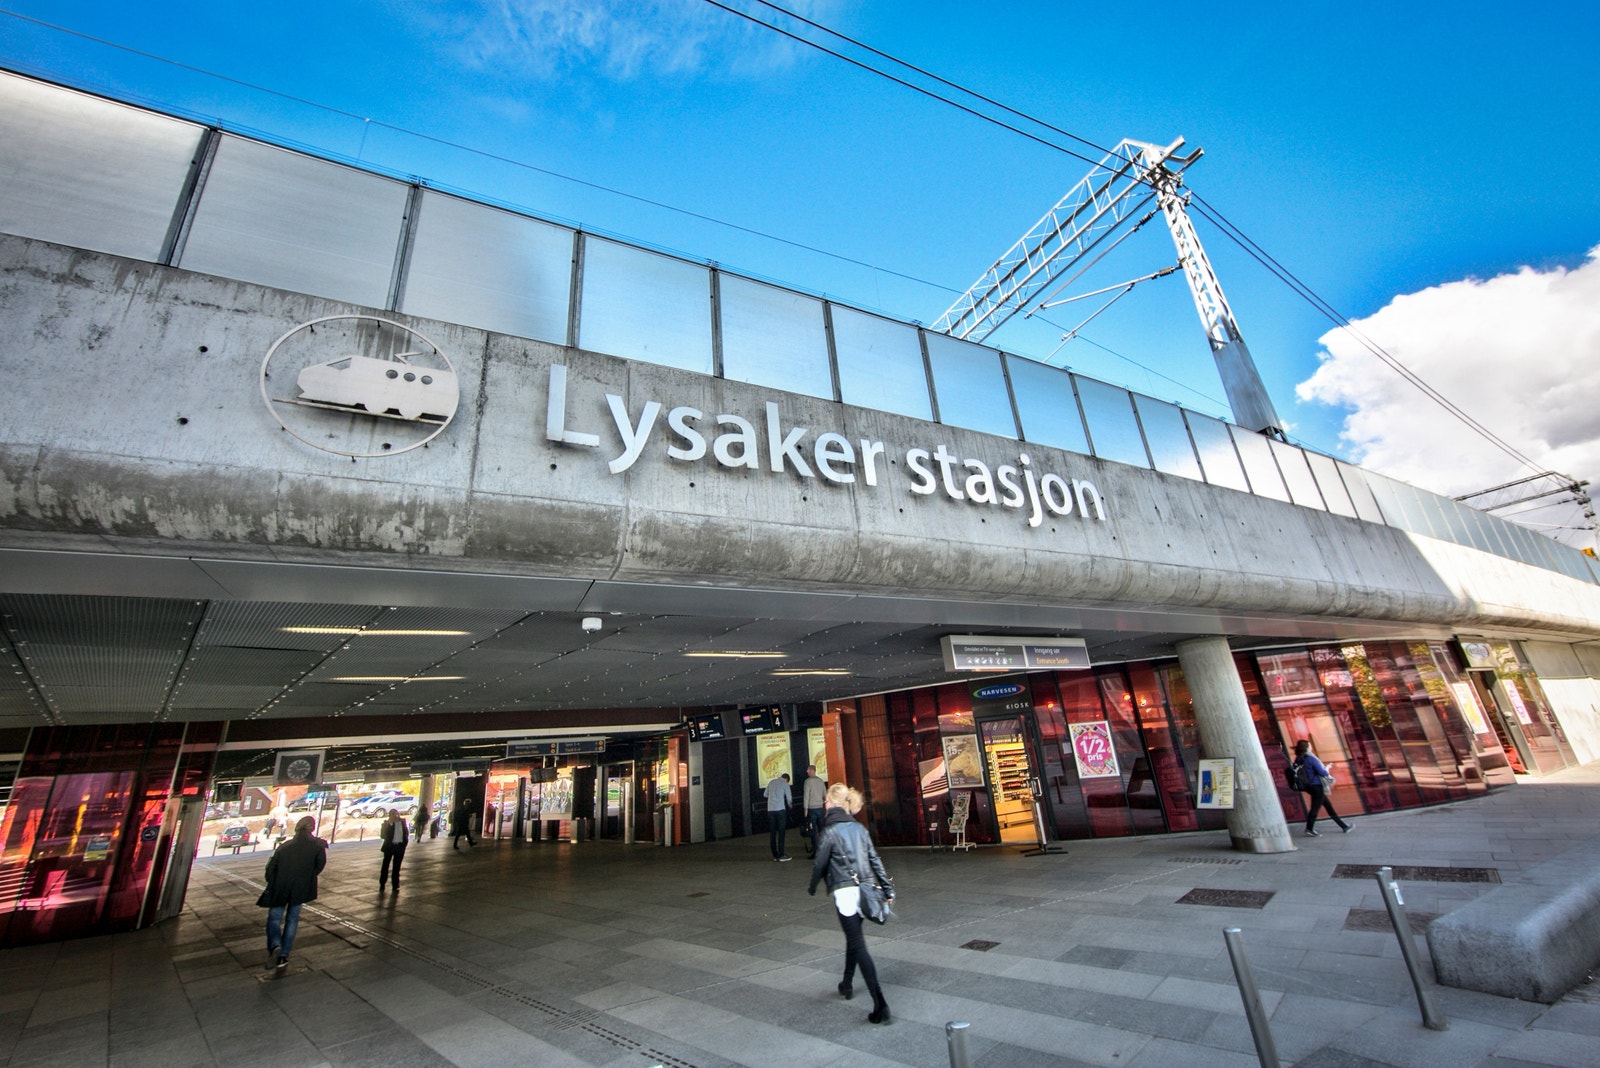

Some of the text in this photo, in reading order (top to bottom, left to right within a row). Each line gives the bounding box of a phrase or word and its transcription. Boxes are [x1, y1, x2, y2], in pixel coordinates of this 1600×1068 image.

[546, 364, 1107, 528] Lysaker stasjon
[981, 687, 1017, 696] NARVESEN
[1006, 702, 1029, 710] KIOSK
[775, 717, 781, 727] 4
[690, 729, 696, 738] 3
[1080, 738, 1106, 754] 1/2
[1087, 753, 1103, 762] pris
